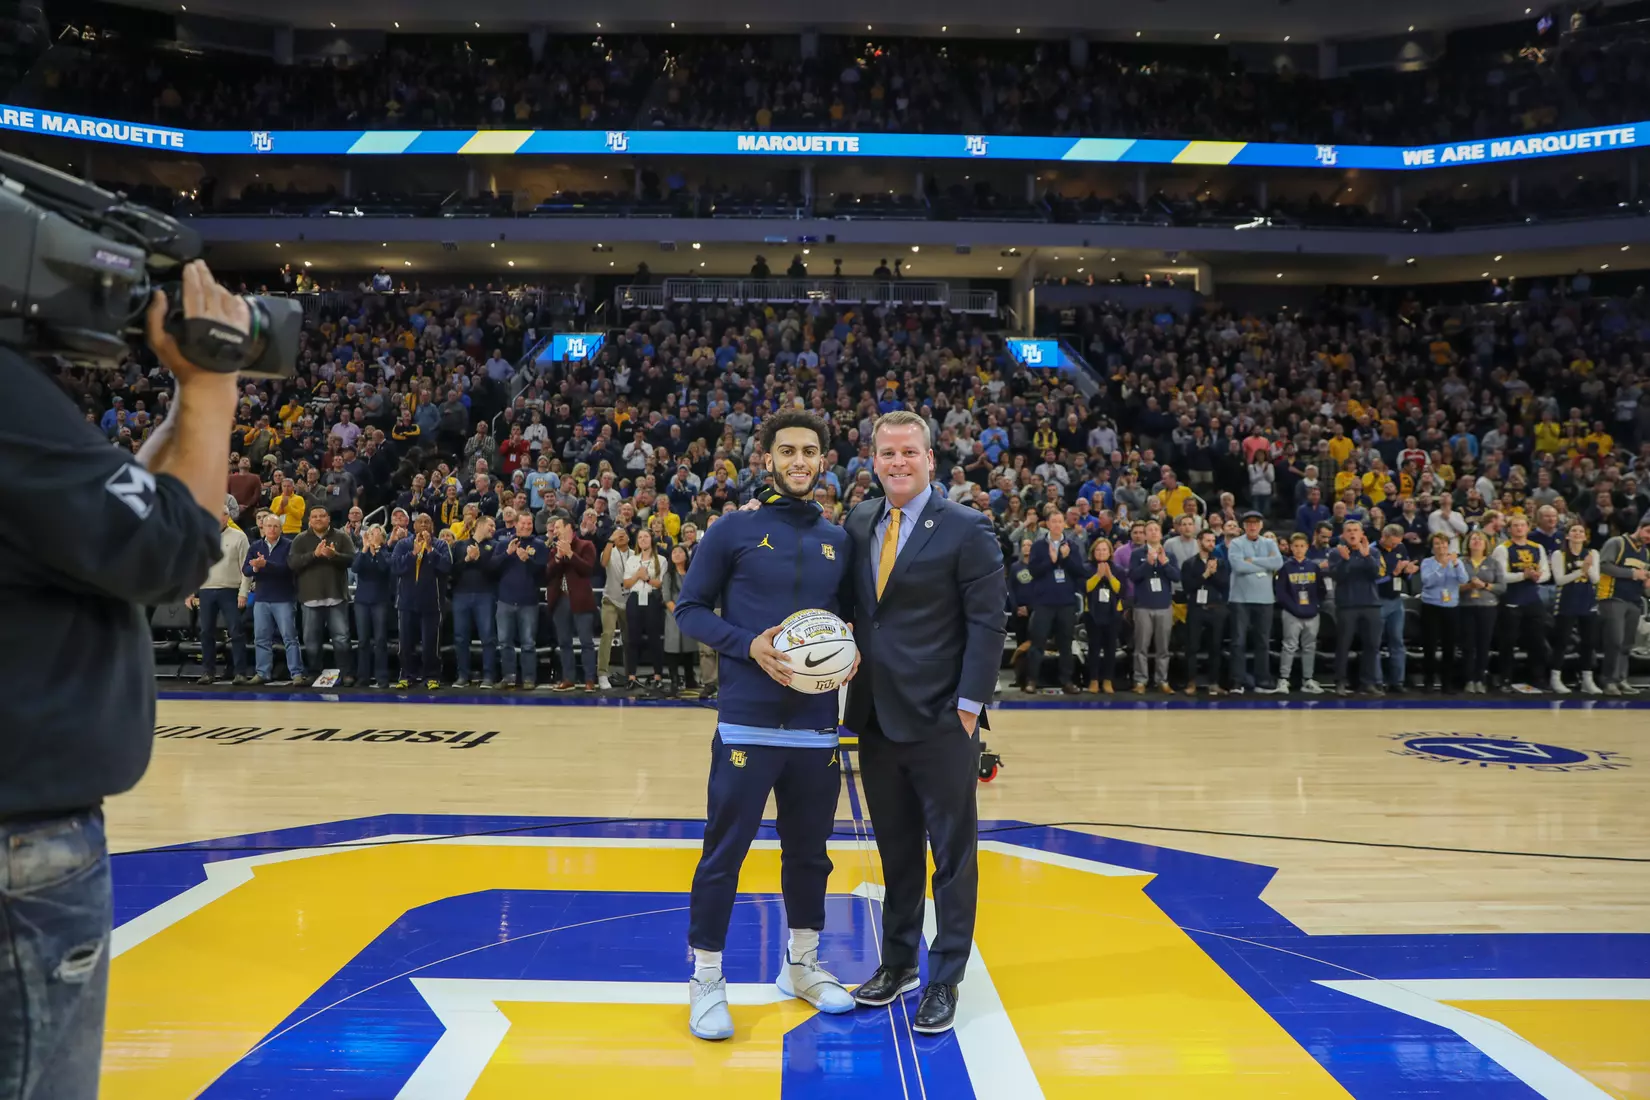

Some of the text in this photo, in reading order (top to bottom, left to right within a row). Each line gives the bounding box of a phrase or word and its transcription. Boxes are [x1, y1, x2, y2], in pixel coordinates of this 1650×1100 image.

[0, 109, 184, 148] RE MARQUETTE
[737, 135, 860, 153] MARQUETTE
[1402, 127, 1636, 166] WE ARE MARQUETTE
[153, 725, 284, 746] foru
